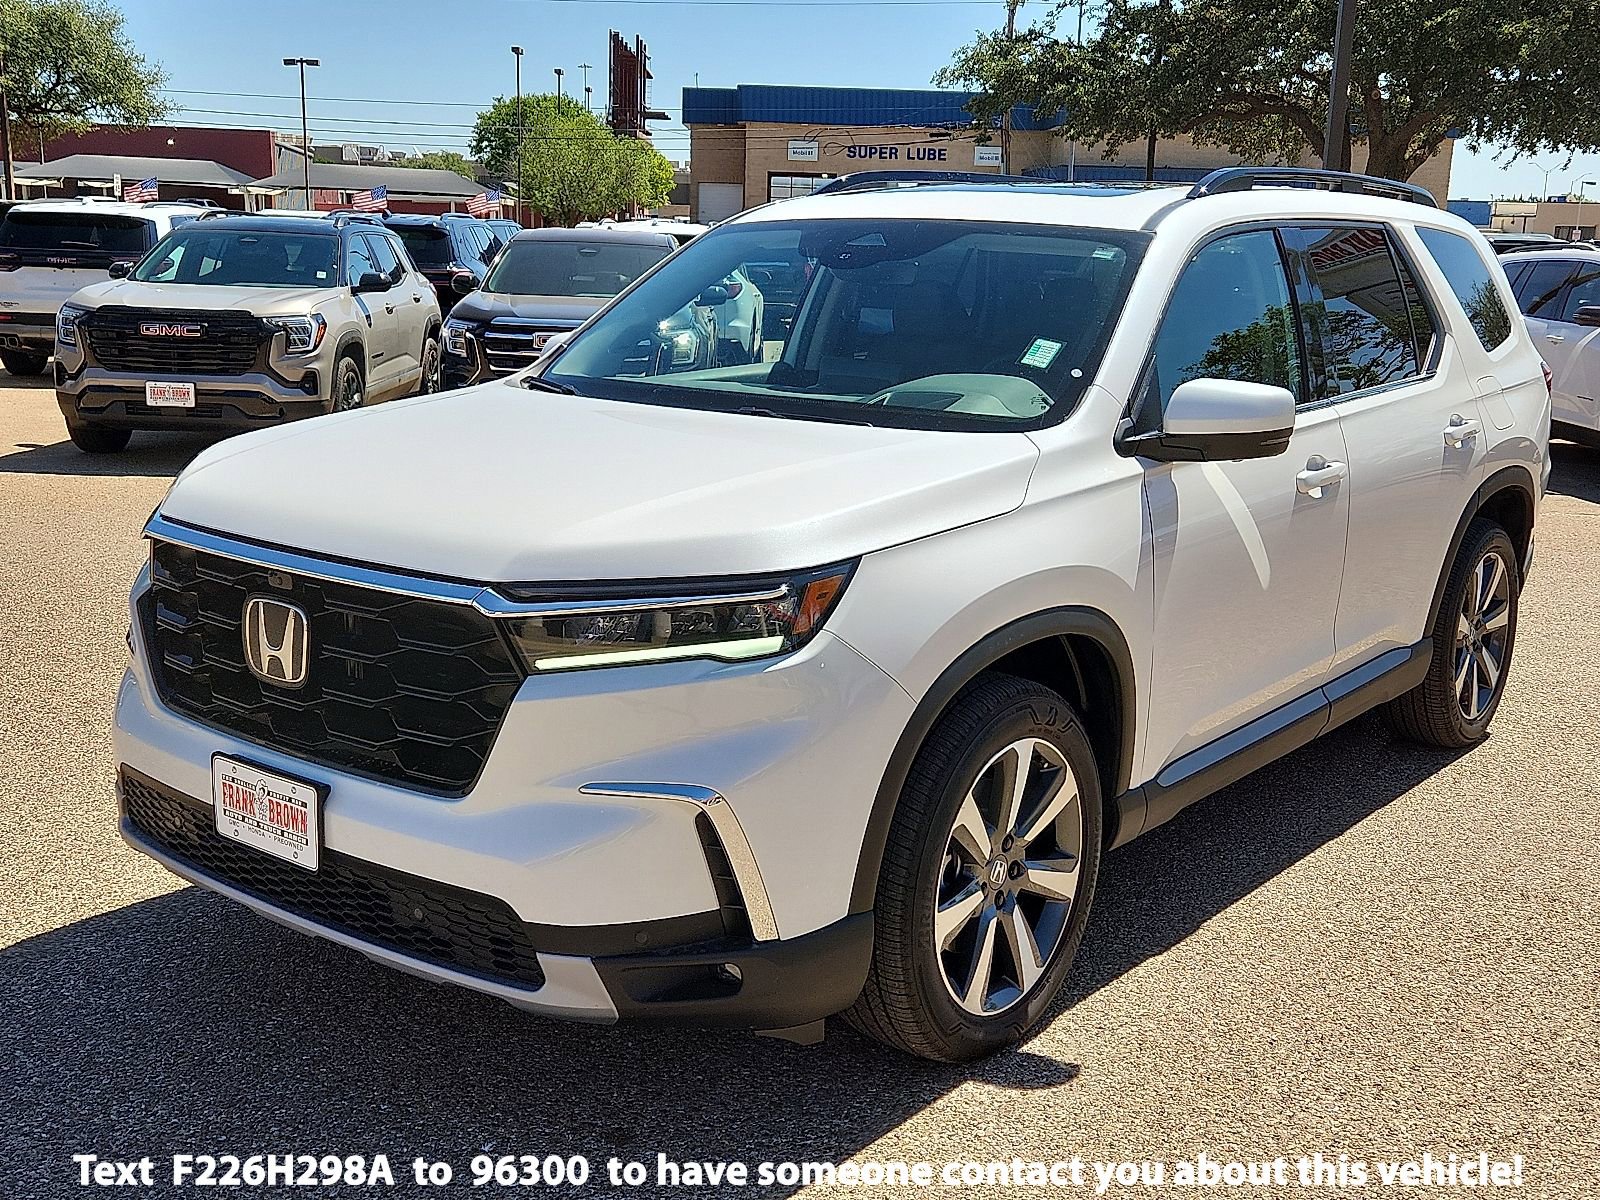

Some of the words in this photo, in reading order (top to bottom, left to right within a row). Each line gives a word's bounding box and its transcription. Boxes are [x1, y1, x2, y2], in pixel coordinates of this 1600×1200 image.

[846, 145, 898, 159] SUPER
[906, 147, 947, 161] LUBE
[140, 323, 201, 337] GMC
[222, 782, 257, 818] FRANK
[268, 798, 308, 837] BROWN
[225, 810, 243, 821] AUTO
[244, 816, 258, 827] AND
[259, 821, 282, 837] TRUCK
[283, 831, 307, 846] RANCH
[247, 825, 266, 838] HONDA
[273, 835, 304, 852] PREOWNED
